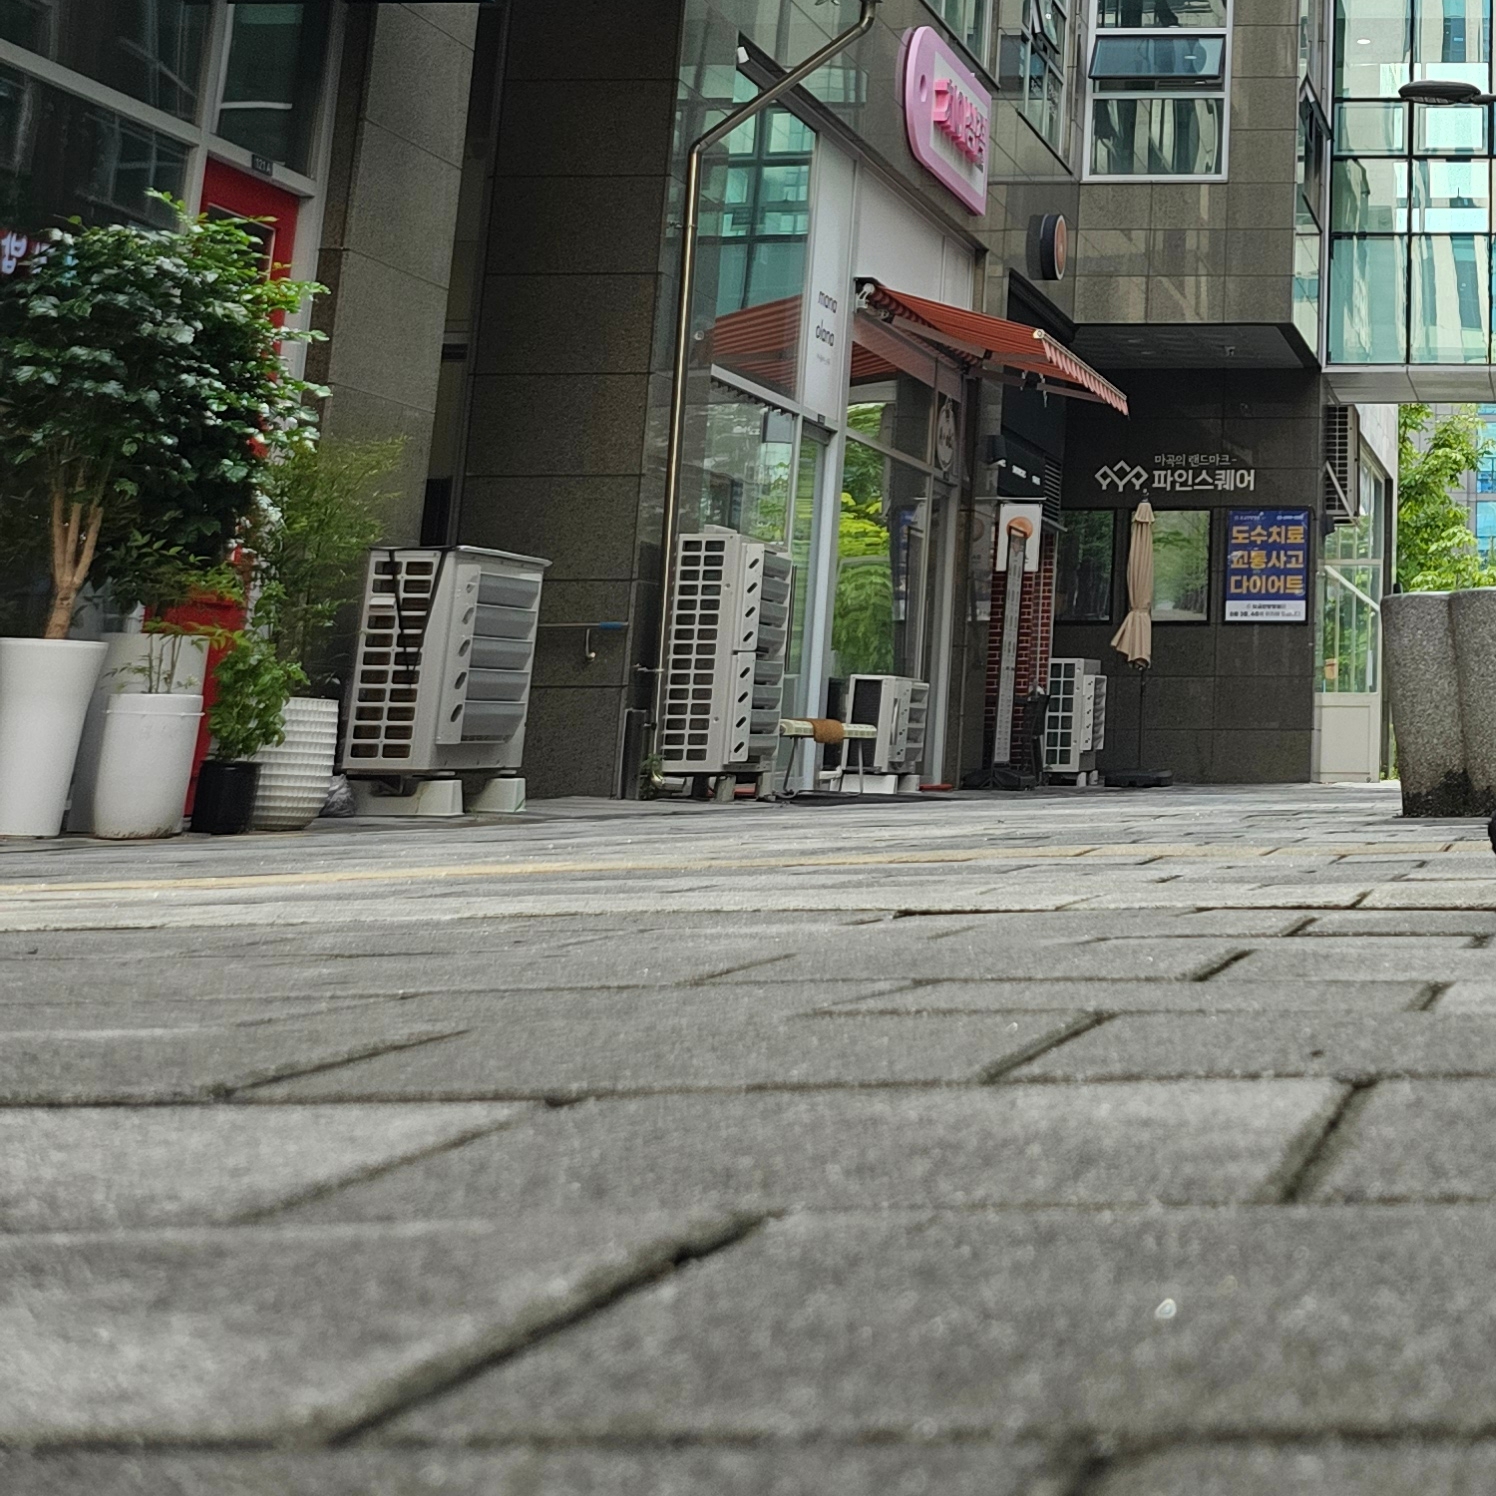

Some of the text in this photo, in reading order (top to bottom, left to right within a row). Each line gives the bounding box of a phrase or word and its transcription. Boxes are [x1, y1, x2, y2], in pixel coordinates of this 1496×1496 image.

[1154, 454, 1187, 467] 마곡의
[1152, 469, 1256, 492] 파인스퀘어
[1231, 525, 1305, 544] 도수치료
[1230, 550, 1305, 569] 교통사고
[1230, 575, 1304, 594] 다이어트
